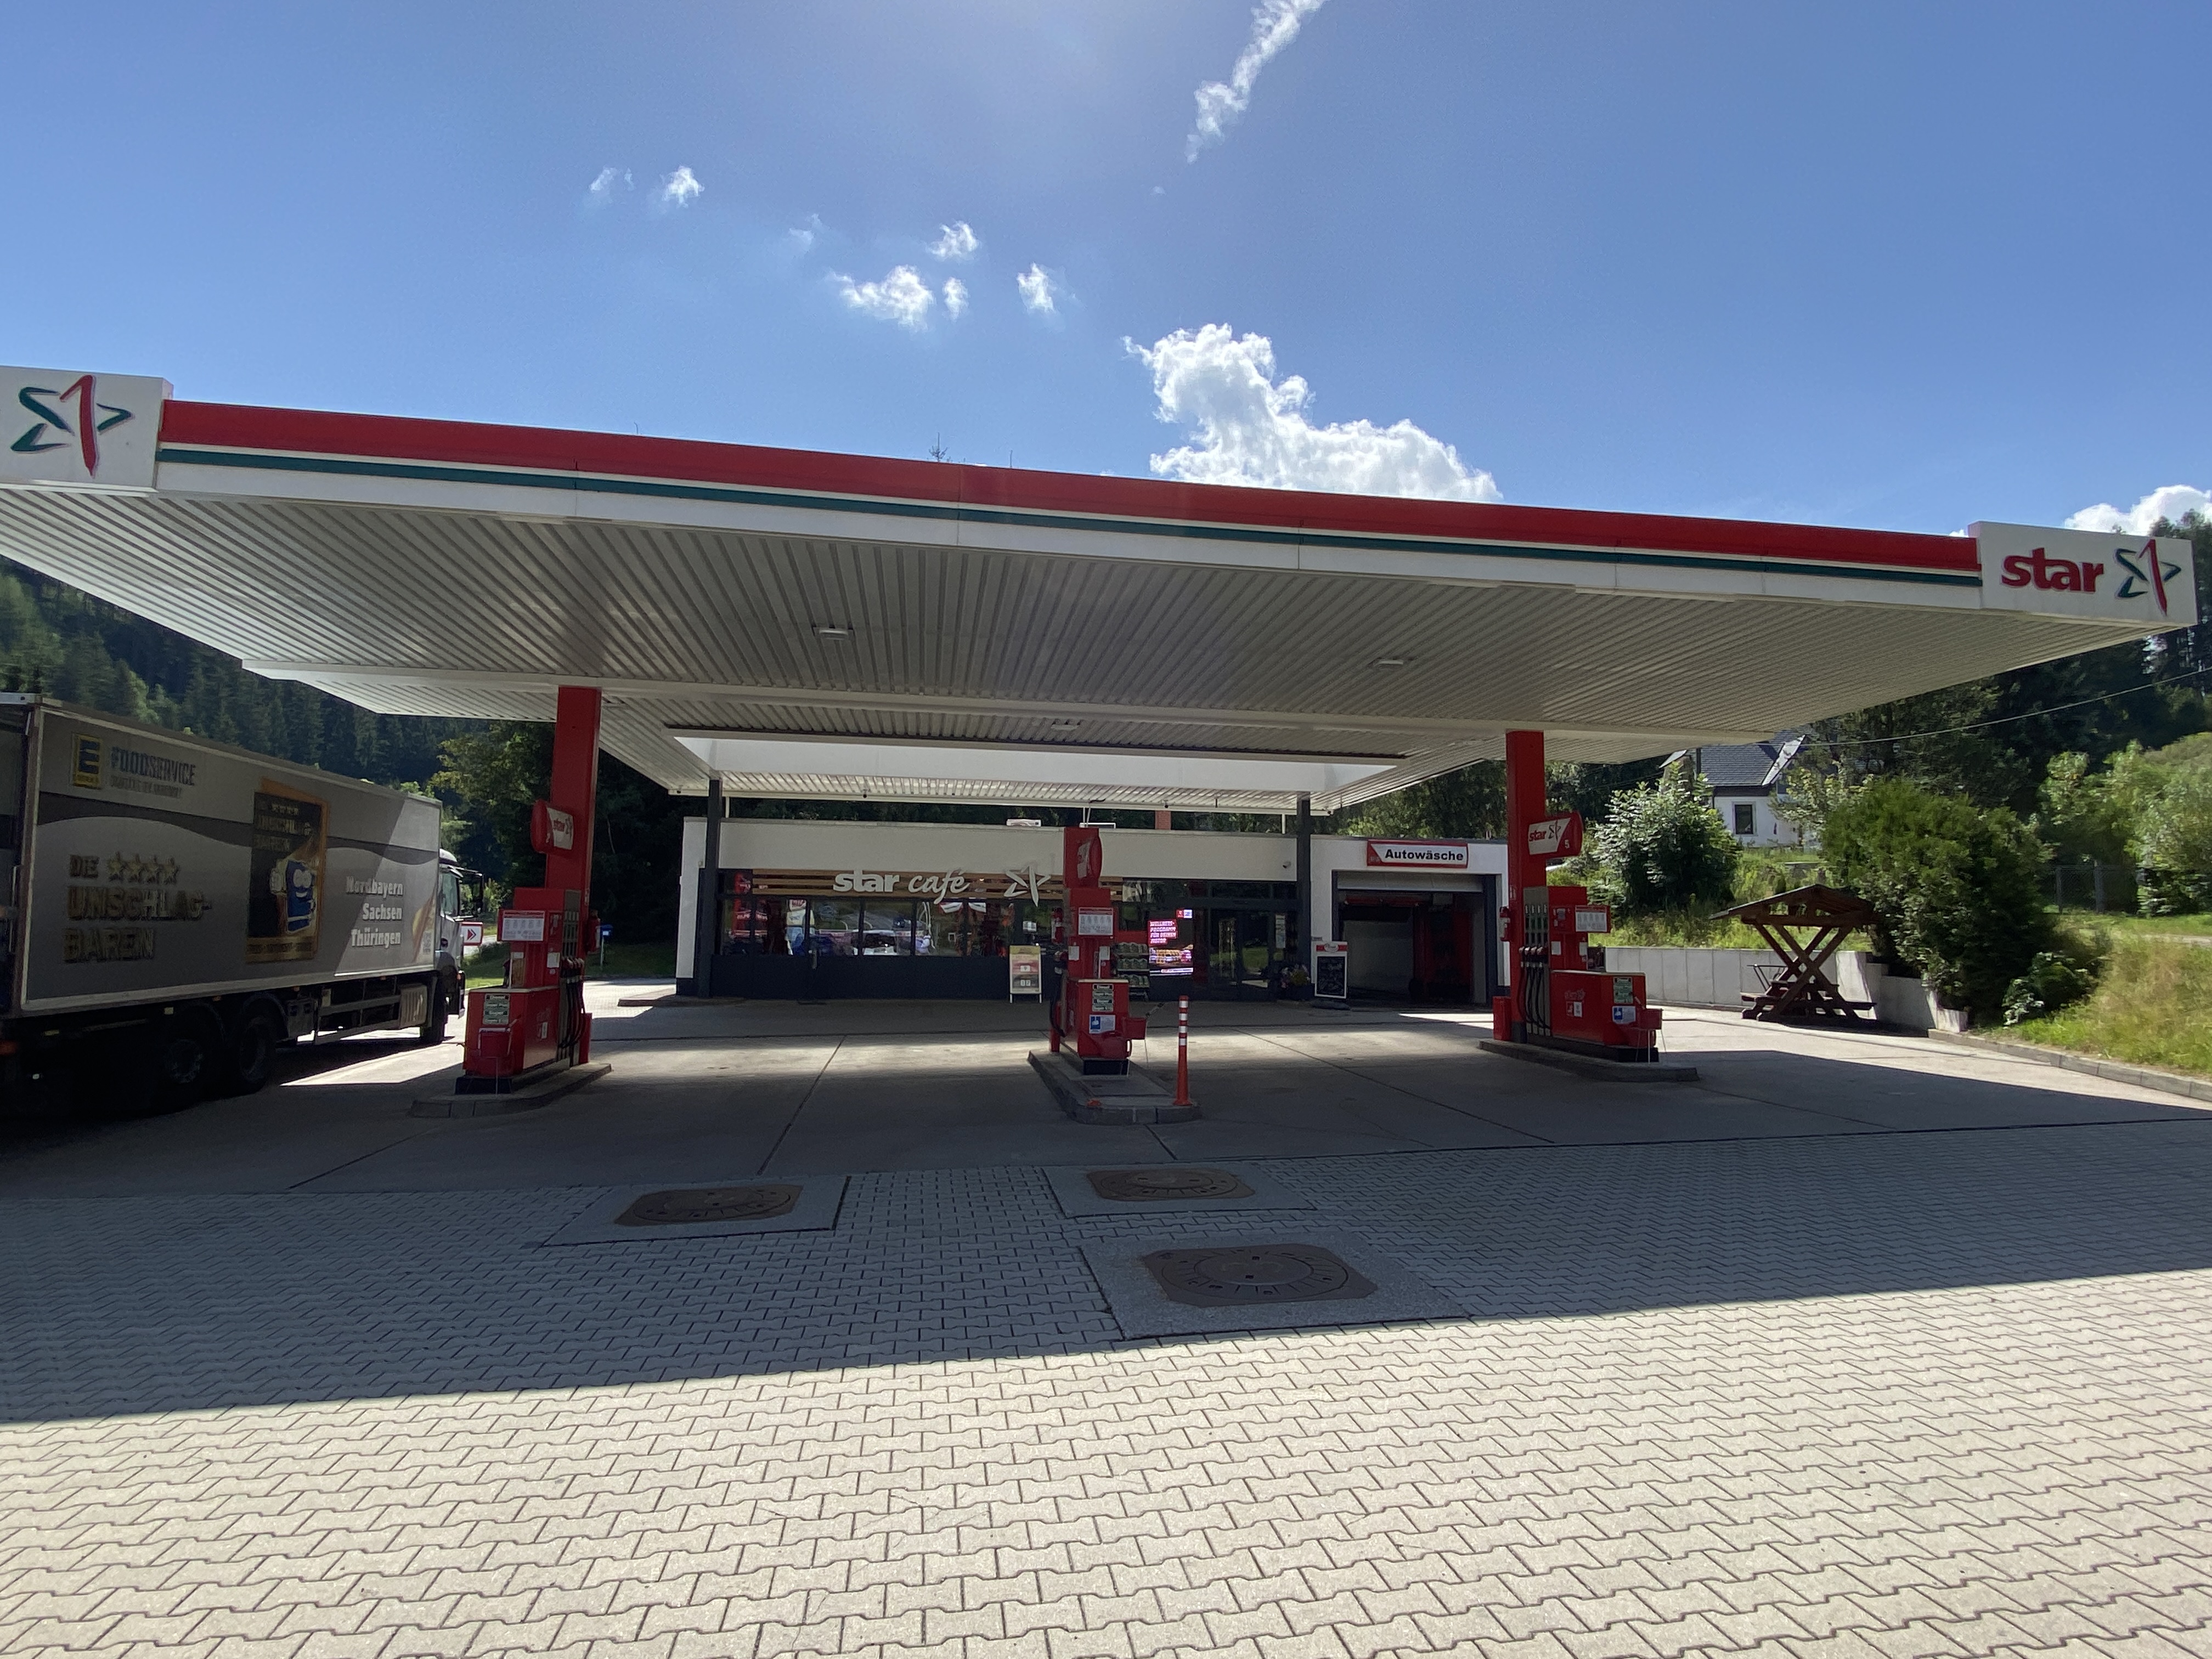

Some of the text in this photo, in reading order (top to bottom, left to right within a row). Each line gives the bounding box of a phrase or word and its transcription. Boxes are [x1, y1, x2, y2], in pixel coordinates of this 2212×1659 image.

[2001, 547, 2104, 593] star
[1528, 830, 1547, 842] star
[1564, 839, 1570, 849] 5
[1385, 849, 1464, 861] Autowäsche
[346, 876, 404, 899] Nordbayern
[833, 868, 971, 905] star café
[362, 902, 403, 921] Sachsen
[351, 927, 402, 949] Thüringen
